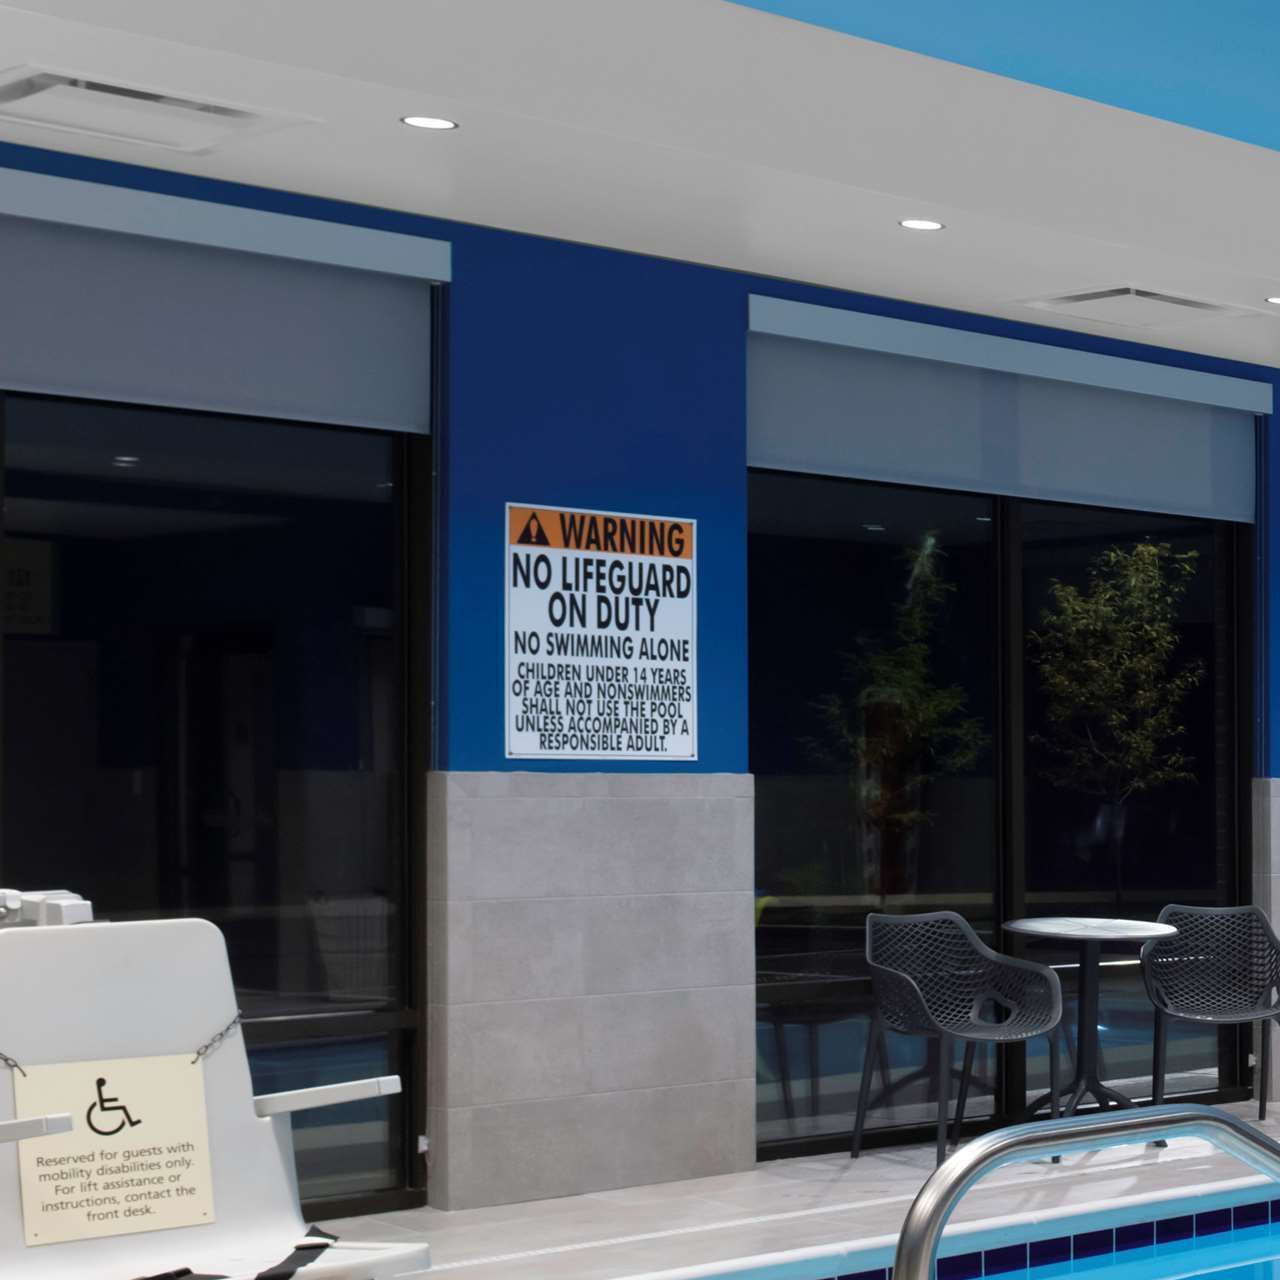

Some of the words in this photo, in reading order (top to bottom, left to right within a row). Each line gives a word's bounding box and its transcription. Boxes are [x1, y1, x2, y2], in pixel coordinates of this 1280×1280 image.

[559, 512, 685, 557] WARNING
[512, 552, 551, 590] NO
[561, 556, 691, 599] LIFEGUARD
[548, 591, 587, 629] ON
[597, 595, 660, 632] DUTY
[513, 630, 540, 655] NO
[546, 632, 634, 659] SWIMMING
[638, 637, 689, 662] ALONE
[517, 661, 582, 682] CHILDREN
[586, 665, 629, 684] UNDER
[633, 667, 647, 683] 14
[650, 667, 687, 685] YEARS
[512, 679, 530, 697] OF
[534, 680, 560, 698] AGE
[564, 681, 592, 699] AND
[596, 682, 692, 702] NONSWIMMERS
[522, 697, 562, 716] SHALL
[566, 699, 593, 717] NOT
[597, 700, 620, 717] USE
[624, 701, 646, 718] THE
[650, 702, 683, 719] POOL
[515, 715, 564, 734] UNLESS
[568, 716, 660, 735] ACCOMPANIED
[663, 718, 679, 736] BY
[680, 719, 690, 736] A
[539, 733, 623, 752] RESPONSIBLE
[626, 734, 668, 753] ADULT.
[36, 1151, 96, 1168] Reserved
[100, 1150, 119, 1161] for
[123, 1145, 163, 1163] guests
[167, 1141, 195, 1155] with
[38, 1167, 93, 1183] mobility
[96, 1159, 162, 1177] disabilities
[165, 1156, 195, 1170] only.
[55, 1183, 76, 1196] For
[80, 1179, 98, 1193] lift
[102, 1174, 164, 1191] assistance
[169, 1173, 181, 1183] or
[41, 1195, 121, 1213] instructions,
[124, 1187, 171, 1203] contact
[176, 1185, 196, 1197] the
[86, 1208, 119, 1222] front
[123, 1205, 156, 1218] desk.
